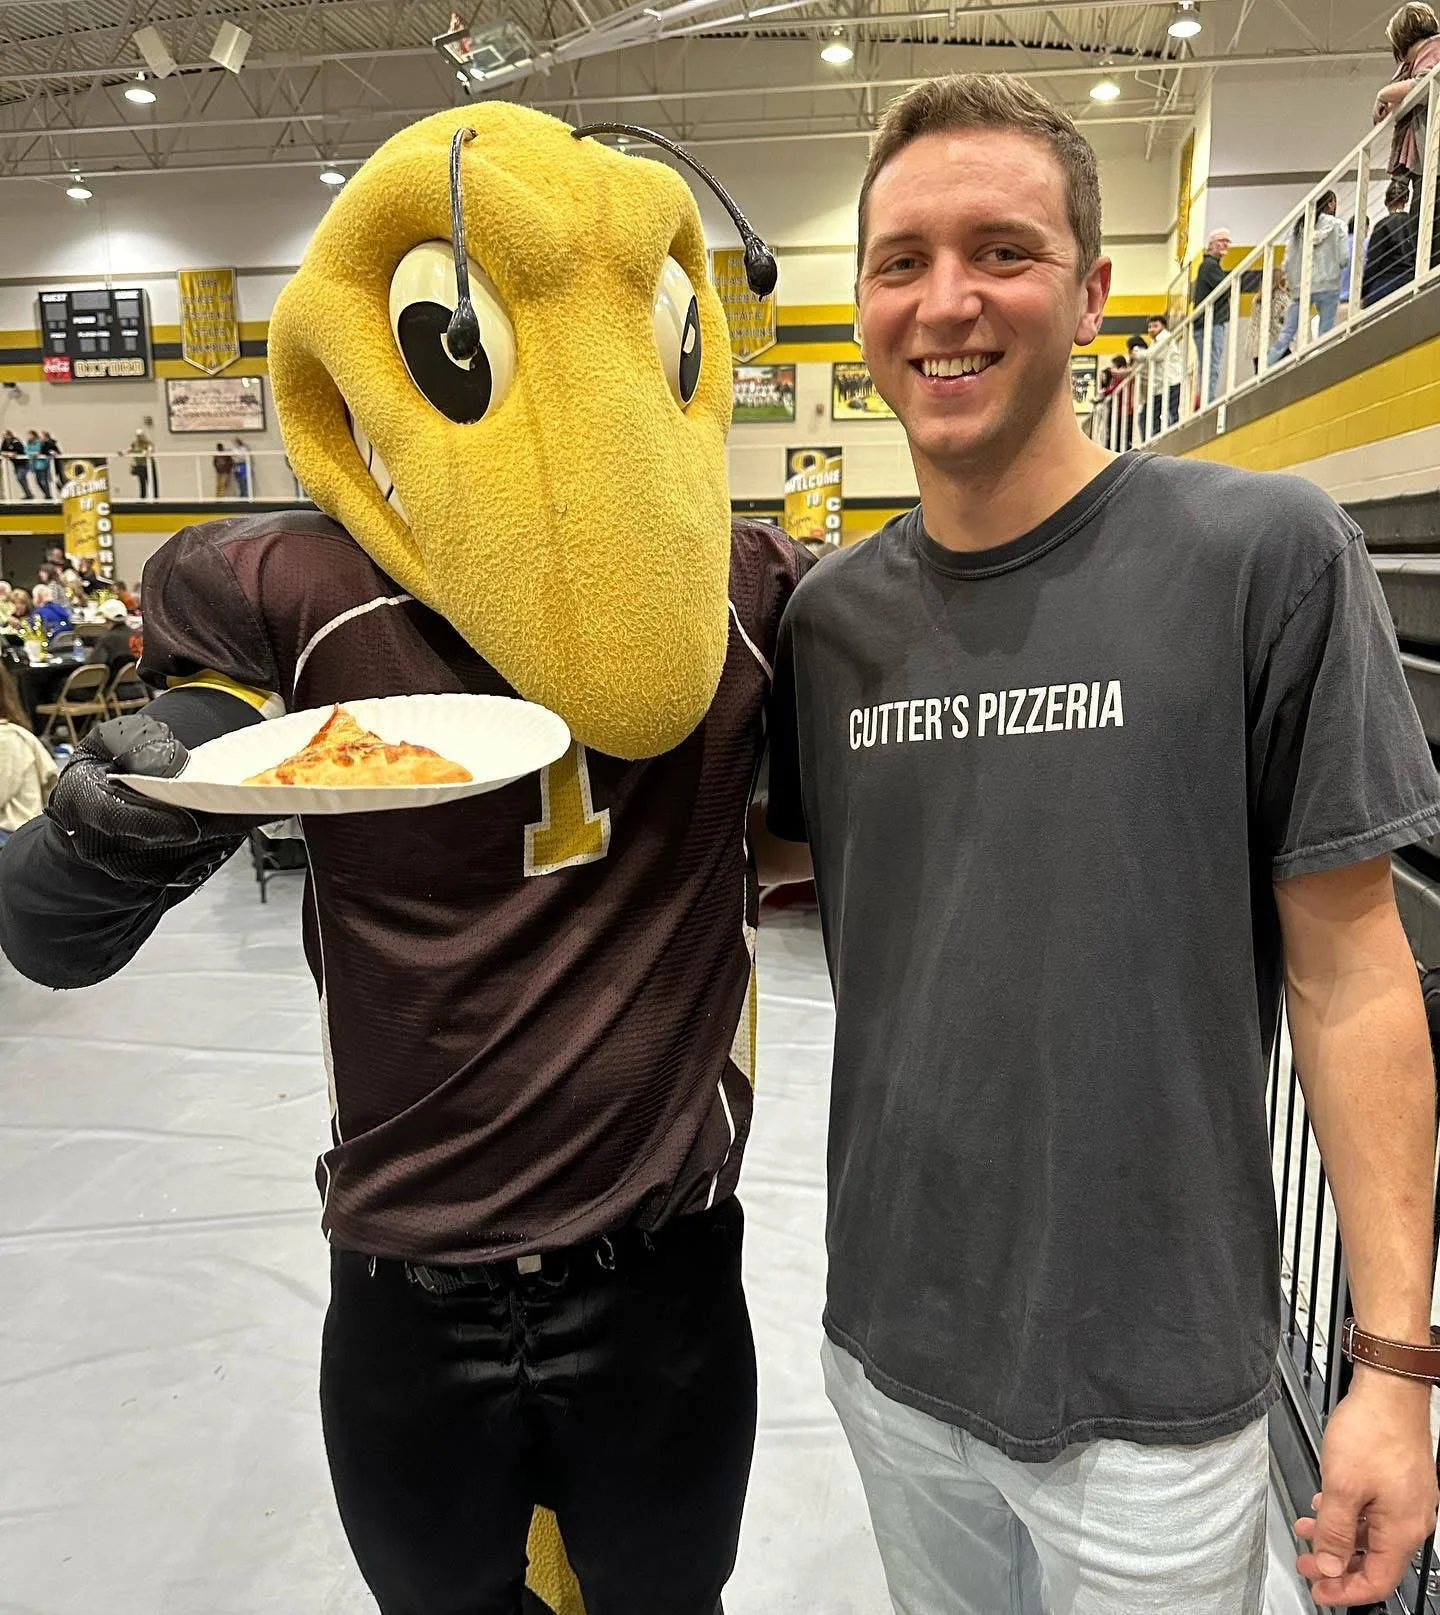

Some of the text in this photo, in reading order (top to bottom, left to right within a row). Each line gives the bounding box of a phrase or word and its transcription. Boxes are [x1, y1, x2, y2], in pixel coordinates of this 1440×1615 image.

[61, 477, 108, 499] WELCOME
[784, 468, 840, 495] WELCOME
[806, 491, 822, 508] TO
[825, 496, 841, 545] COU
[96, 502, 113, 578] COURT
[849, 679, 1124, 750] CUTTER'S PIZZERIA
